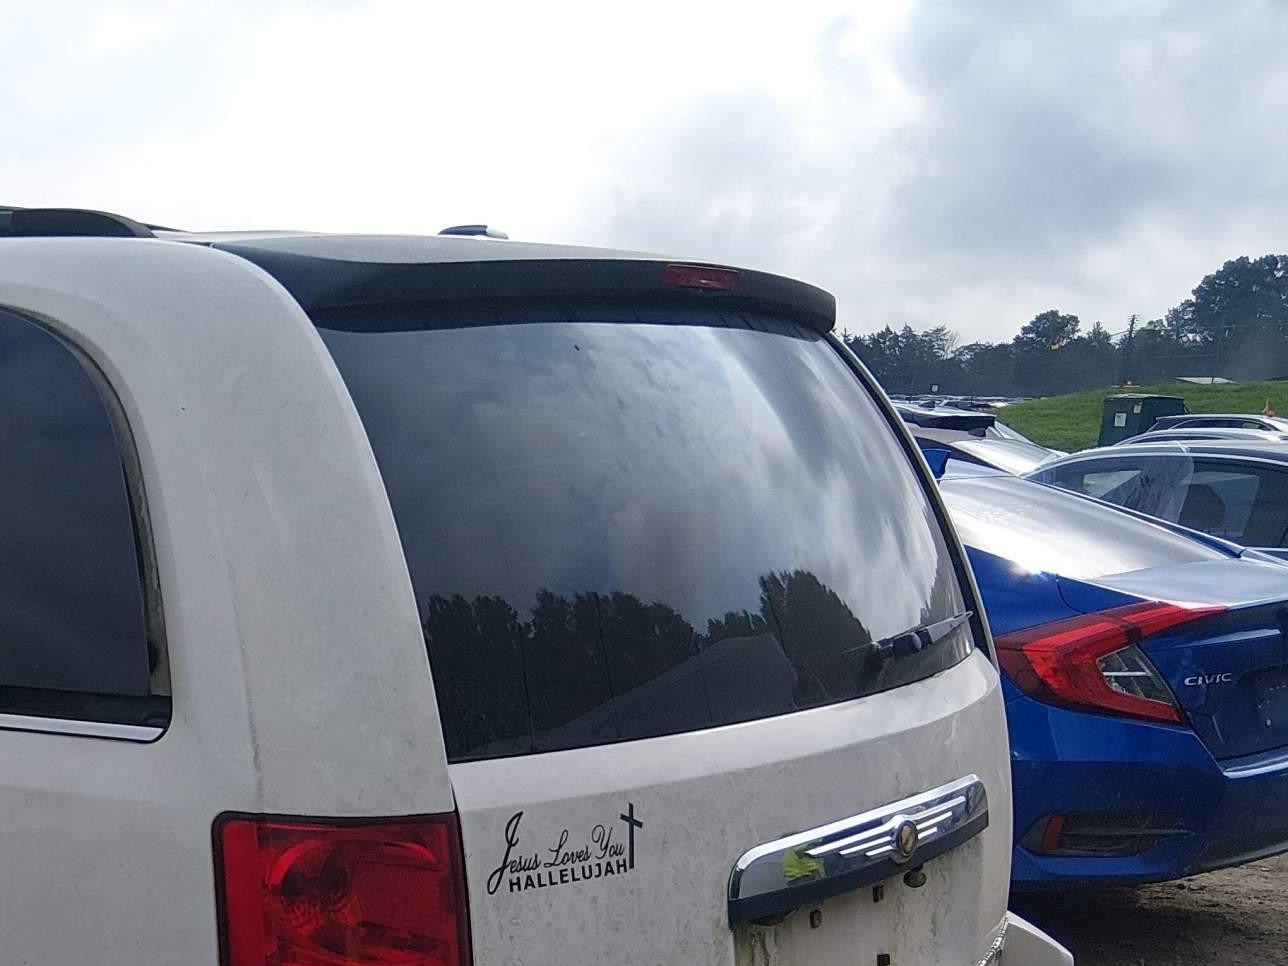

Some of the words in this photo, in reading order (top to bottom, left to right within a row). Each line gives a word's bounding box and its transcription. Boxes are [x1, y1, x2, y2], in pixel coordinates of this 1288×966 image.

[1184, 672, 1232, 686] CIVIC
[487, 811, 541, 895] Jesus
[544, 829, 591, 868] Loves
[592, 825, 625, 859] You
[509, 858, 628, 893] HALLELUJAH
